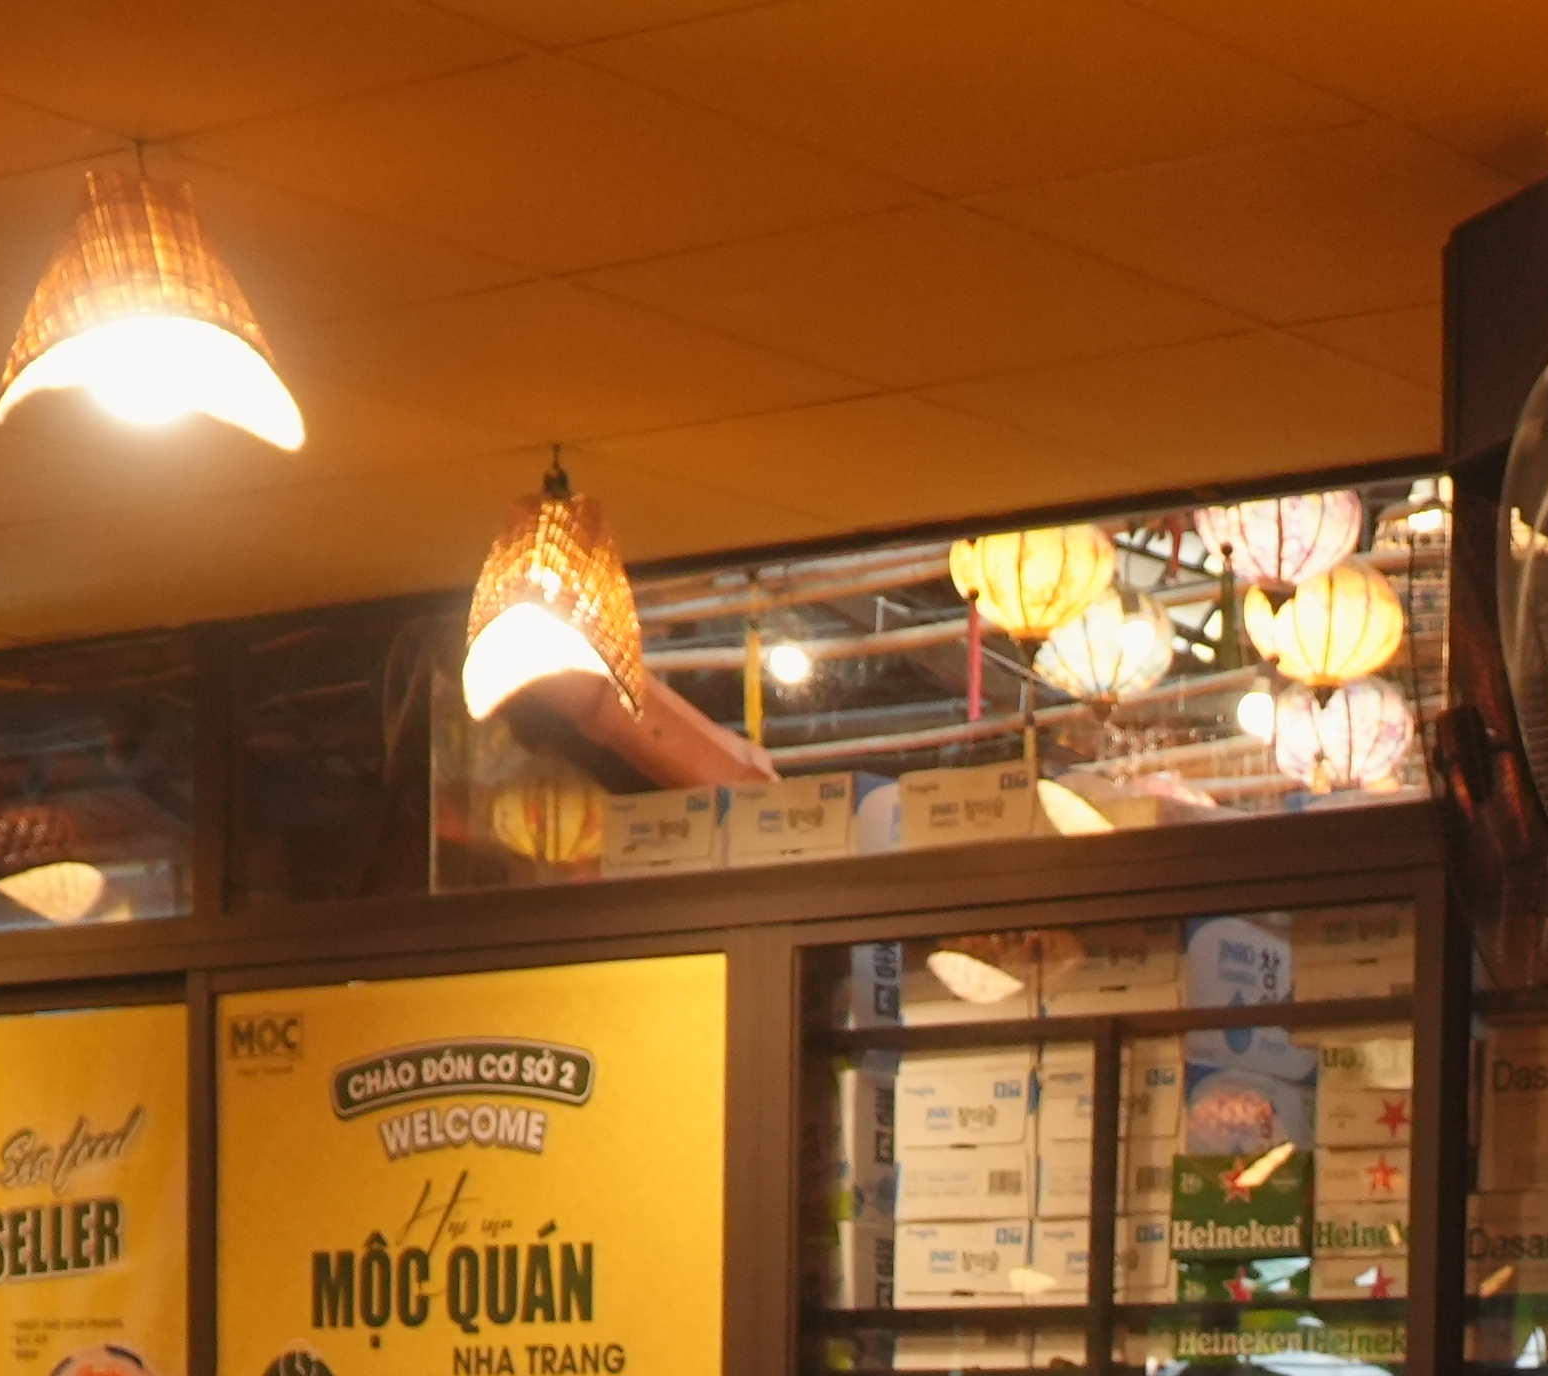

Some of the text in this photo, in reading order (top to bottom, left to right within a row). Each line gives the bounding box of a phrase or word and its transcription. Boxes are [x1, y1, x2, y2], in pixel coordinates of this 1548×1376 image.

[347, 1048, 578, 1100] CHÀO ĐÓN CƠ SỞ 2
[380, 1104, 547, 1162] WELCOME
[1171, 1218, 1301, 1251] Heineken
[312, 1220, 595, 1349] MỘC QUÁN
[526, 1343, 626, 1376] TRANG
